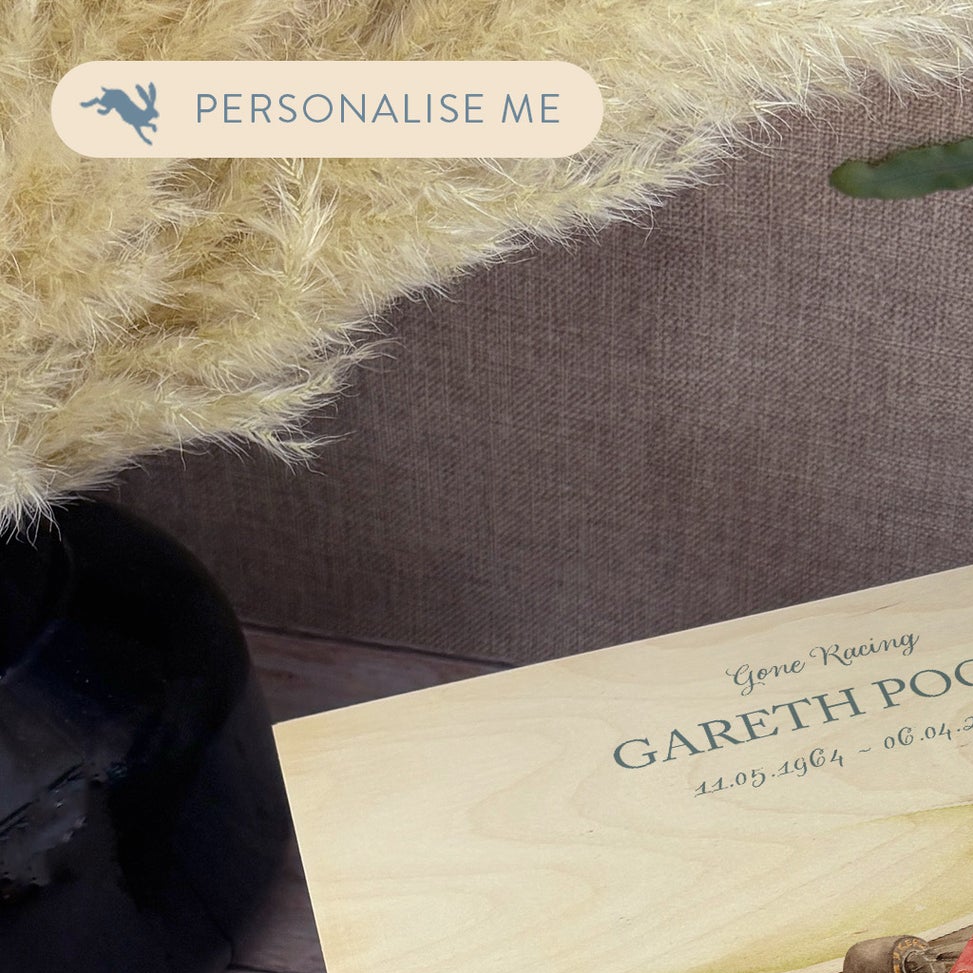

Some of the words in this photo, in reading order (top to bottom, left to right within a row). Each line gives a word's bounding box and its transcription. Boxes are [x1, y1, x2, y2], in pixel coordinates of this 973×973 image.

[725, 659, 806, 697] Gone
[808, 633, 920, 667] Racing
[613, 687, 867, 770] GARETH
[694, 747, 846, 798] 11.05.1964
